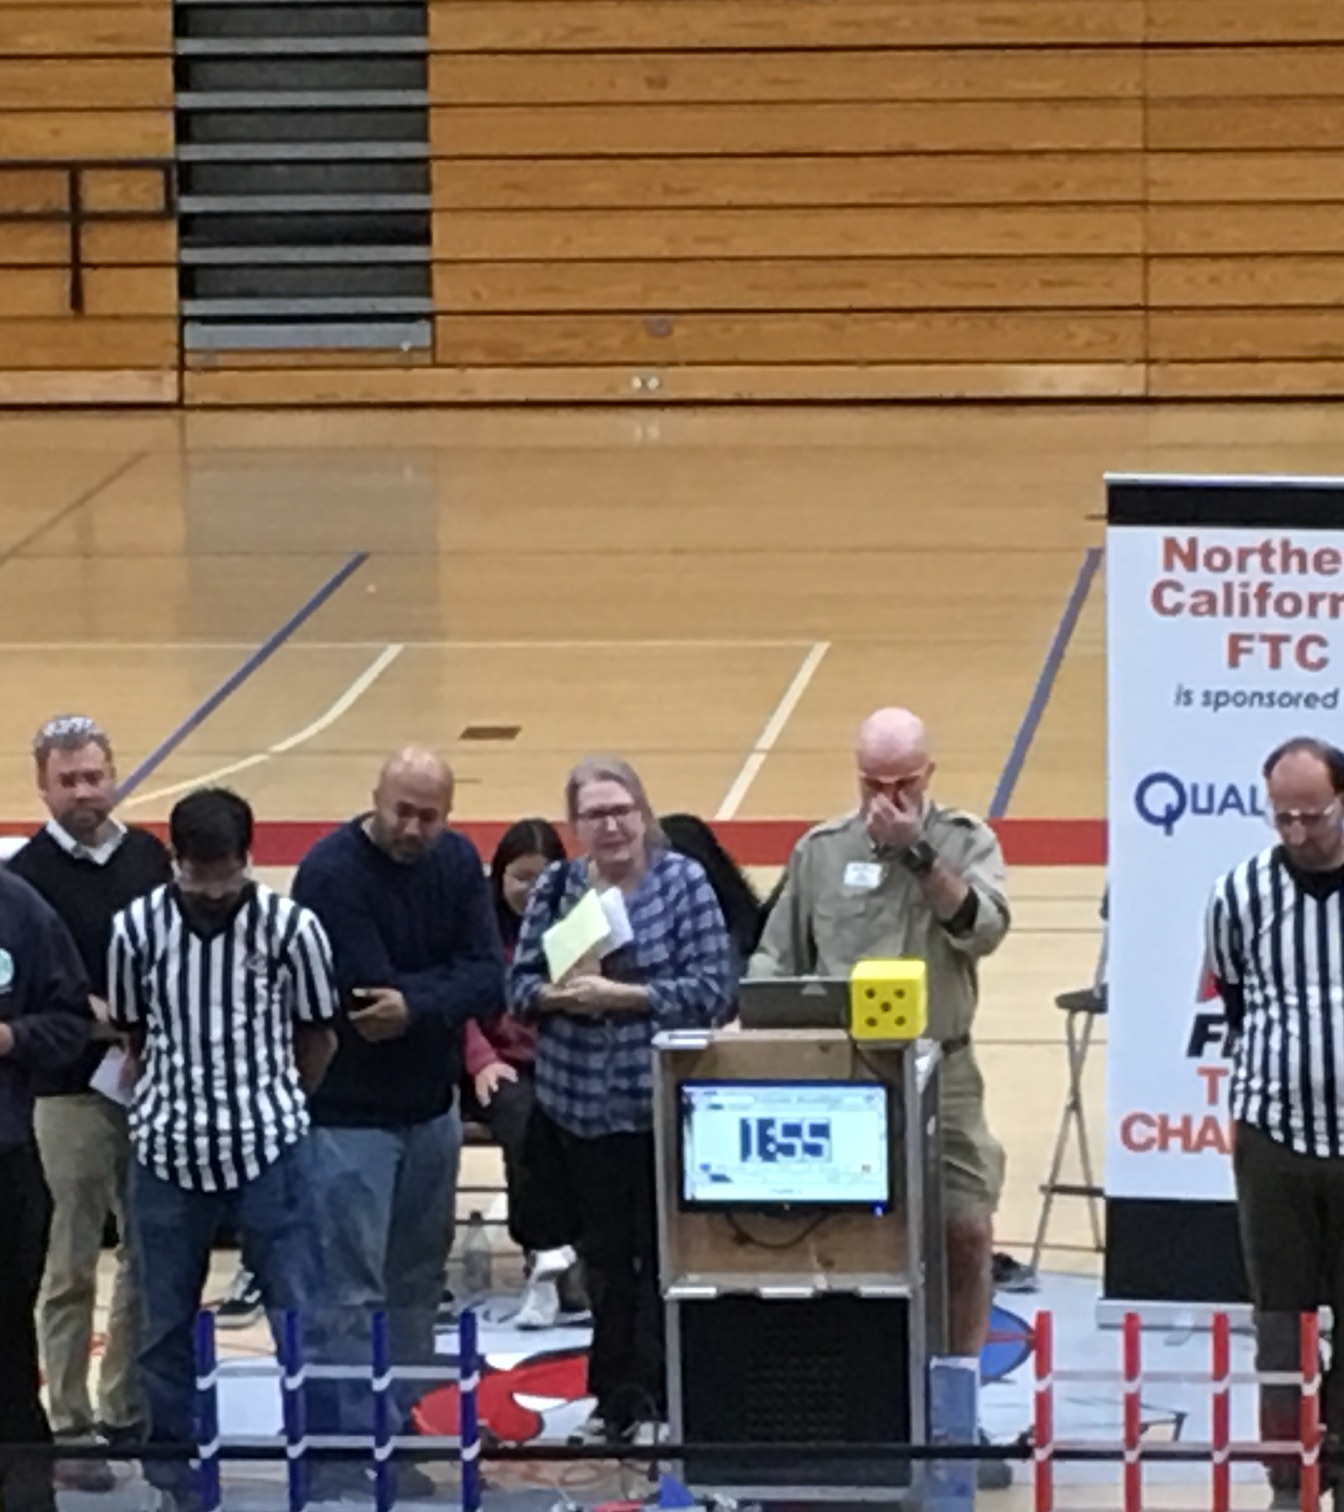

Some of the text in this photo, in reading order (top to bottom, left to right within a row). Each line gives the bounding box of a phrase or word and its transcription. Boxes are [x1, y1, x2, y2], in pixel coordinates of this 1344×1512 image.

[1225, 632, 1331, 672] FTC
[1174, 684, 1194, 707] is
[1201, 686, 1340, 713] sponsored
